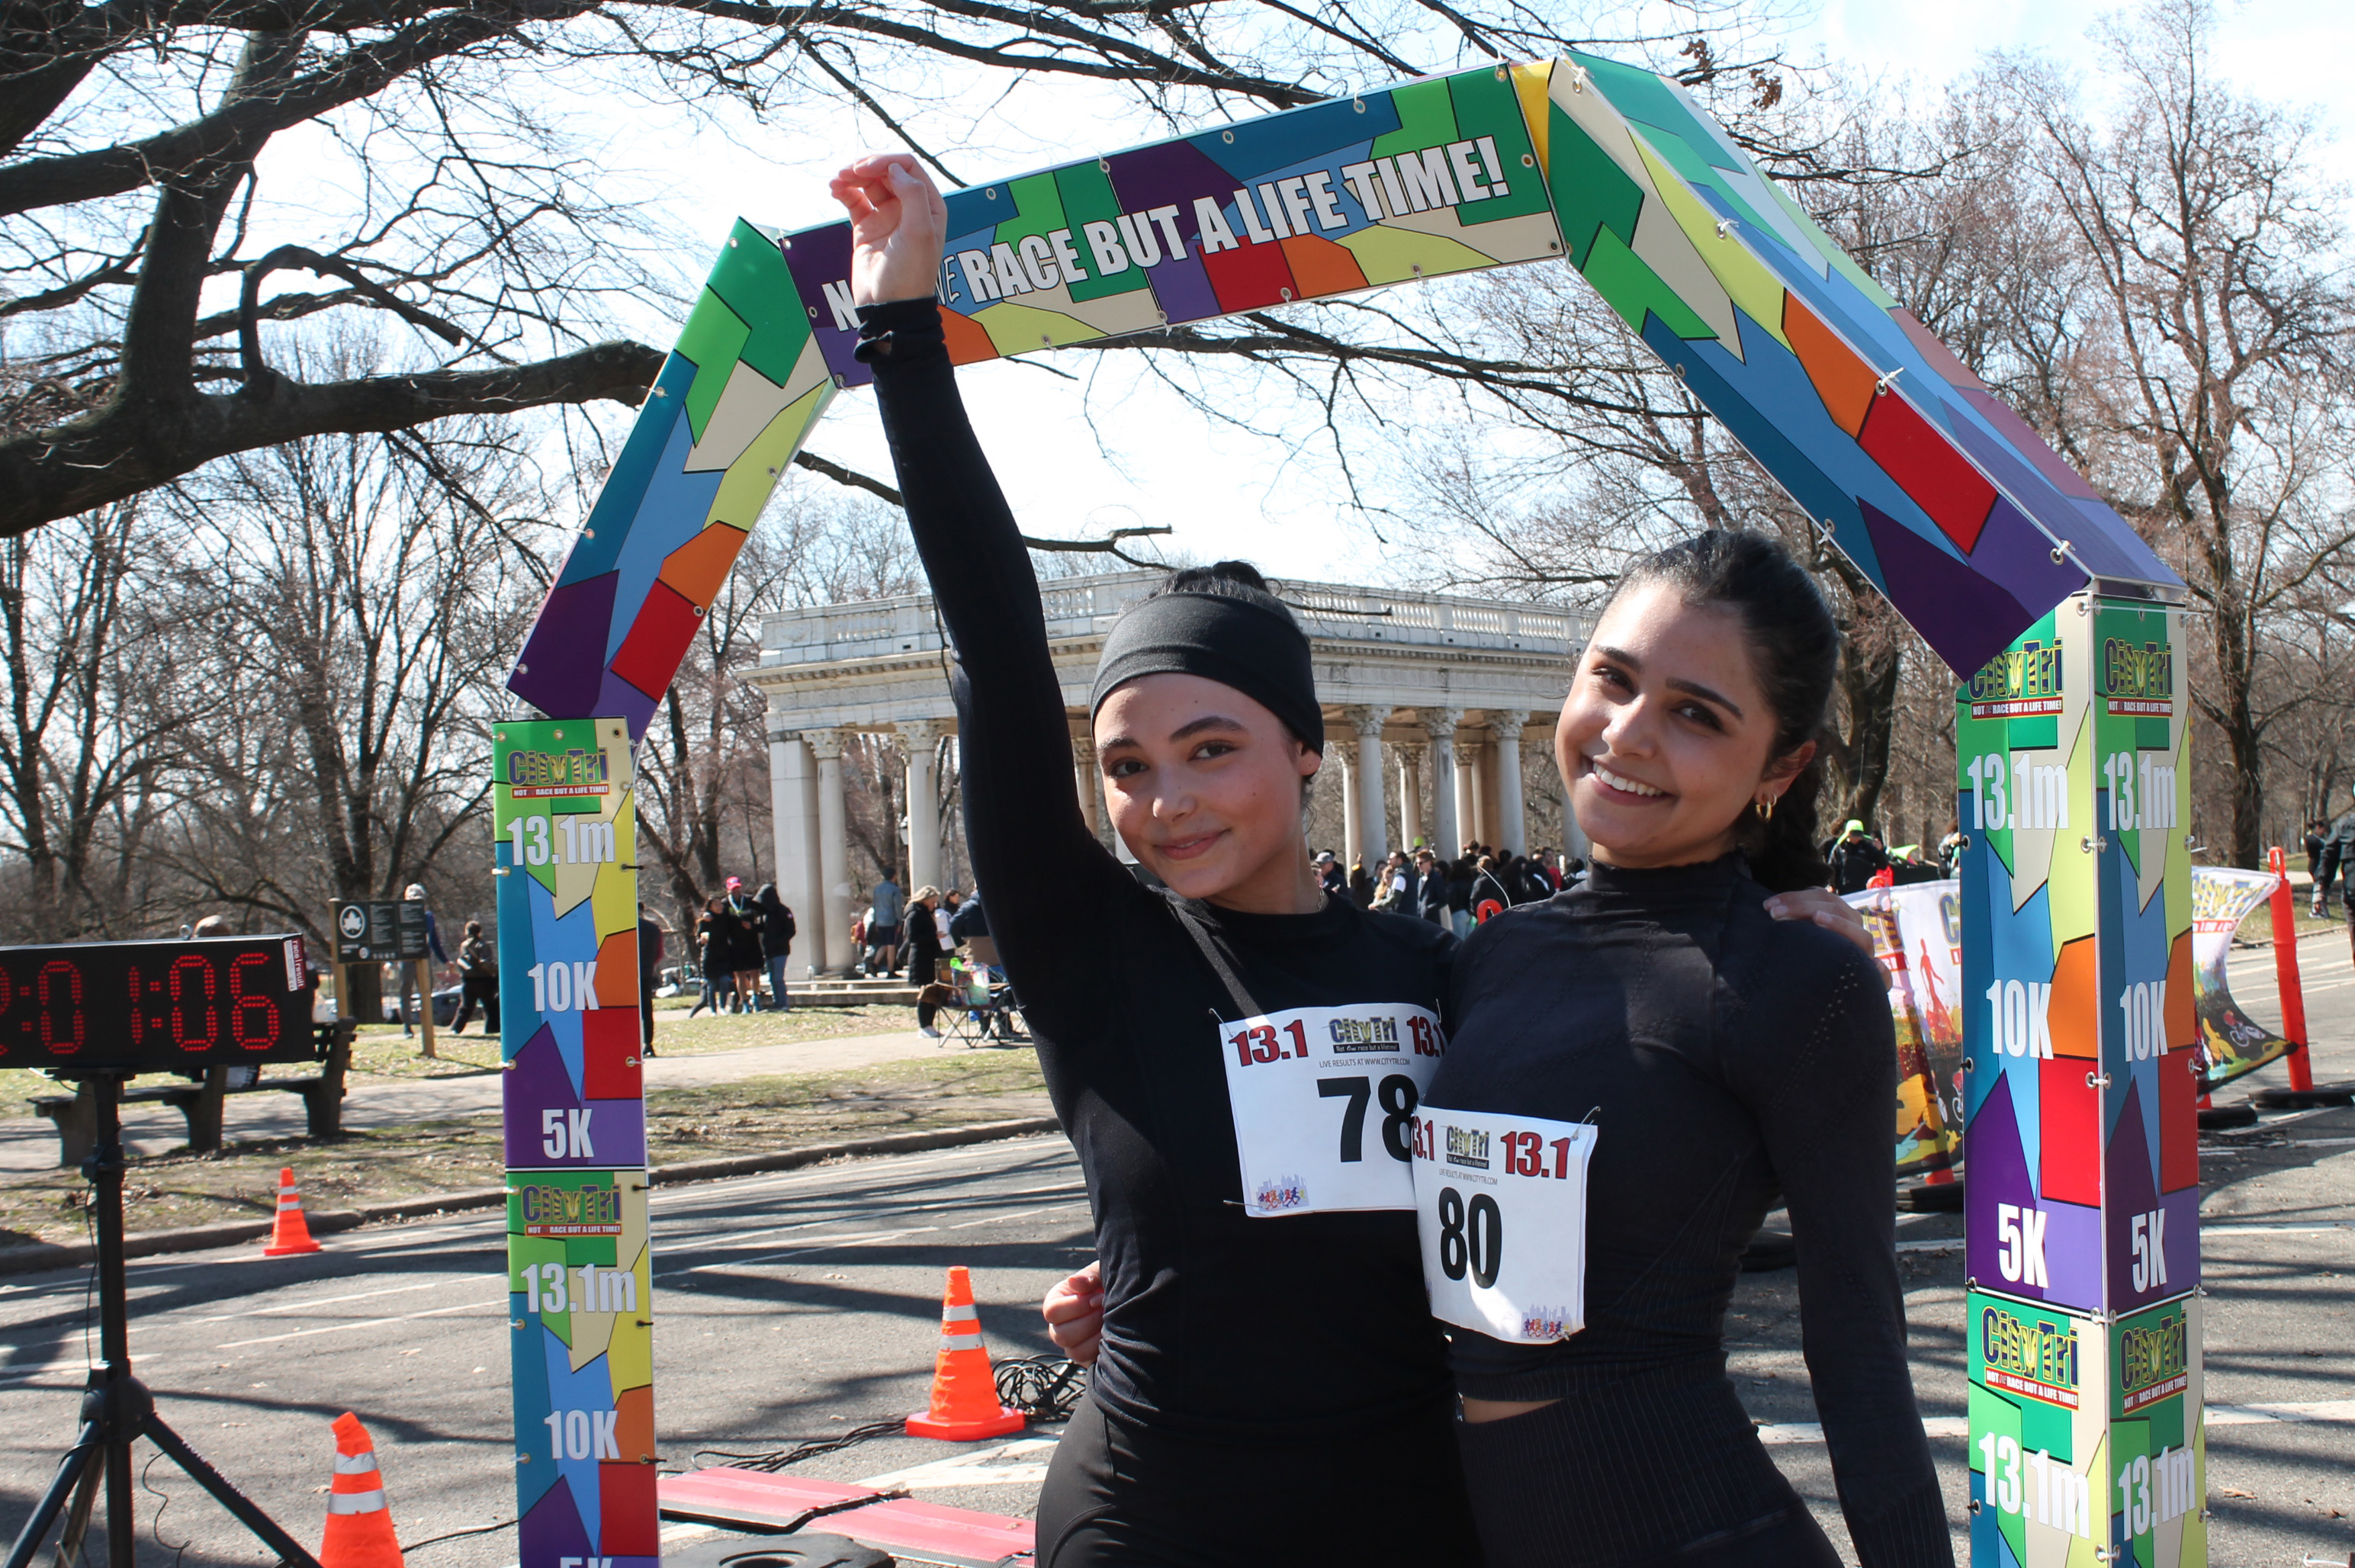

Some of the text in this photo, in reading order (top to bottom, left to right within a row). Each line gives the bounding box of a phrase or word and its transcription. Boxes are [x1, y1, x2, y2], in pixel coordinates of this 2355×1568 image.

[956, 228, 1089, 304] RACE
[1082, 204, 1188, 277] BUT
[1192, 196, 1240, 255] A
[1233, 169, 1348, 245] LIFE
[1340, 134, 1511, 221] TIME!
[2104, 637, 2173, 699] CityTri
[1972, 705, 1985, 715] NOT
[1992, 703, 2009, 714] RACE
[2010, 702, 2023, 713] BUT
[2023, 702, 2029, 712] A
[2029, 701, 2042, 712] LIFE
[2042, 700, 2062, 711] TIME!
[2108, 700, 2118, 711] NOT
[2123, 701, 2135, 712] RACE
[2136, 702, 2146, 712] BUT
[2146, 702, 2150, 712] A
[2150, 702, 2159, 712] LIFE
[2159, 702, 2172, 713] TIME!
[508, 747, 609, 786] CityTri
[1967, 752, 2069, 831] 13.1m
[2103, 751, 2177, 831] 13.1m
[506, 815, 615, 866] 13.1m
[0, 953, 280, 1056] :01:06
[527, 961, 599, 1012] 10K
[1228, 1019, 1309, 1068] 13.1
[1329, 1016, 1398, 1043] CityTri
[1986, 978, 2055, 1060] 10K
[2119, 980, 2168, 1062] 10K
[1332, 1059, 1356, 1067] RESULTS
[1364, 1057, 1410, 1065] WWW.CITYTRI.COM
[542, 1108, 594, 1159] 5K
[1316, 1074, 1418, 1162] 78
[1447, 1125, 1489, 1158] CityTri
[1500, 1131, 1571, 1180] 13.1
[522, 1184, 622, 1224] CityTri
[1438, 1187, 1502, 1289] 80
[1998, 1202, 2048, 1288] 5K
[2132, 1207, 2167, 1293] 5K
[520, 1263, 636, 1313] 13.1m
[1981, 1306, 2079, 1388] CityTri
[2120, 1309, 2187, 1392] CityTri
[1986, 1370, 2000, 1383] NOT
[2006, 1375, 2023, 1390] RACE
[2024, 1380, 2038, 1395] BUT
[2038, 1385, 2044, 1396] A
[2044, 1386, 2058, 1401] LIFE
[2058, 1390, 2077, 1406] TIME!
[2124, 1396, 2134, 1409] NOT
[2138, 1389, 2151, 1403] RACE
[2151, 1385, 2161, 1399] BUT
[2161, 1383, 2165, 1395] A
[2165, 1380, 2174, 1393] LIFE
[2174, 1375, 2186, 1390] TIME!
[544, 1409, 620, 1460] 10K
[1978, 1431, 2090, 1540] 13.1m
[2118, 1446, 2196, 1542] 13.1m
